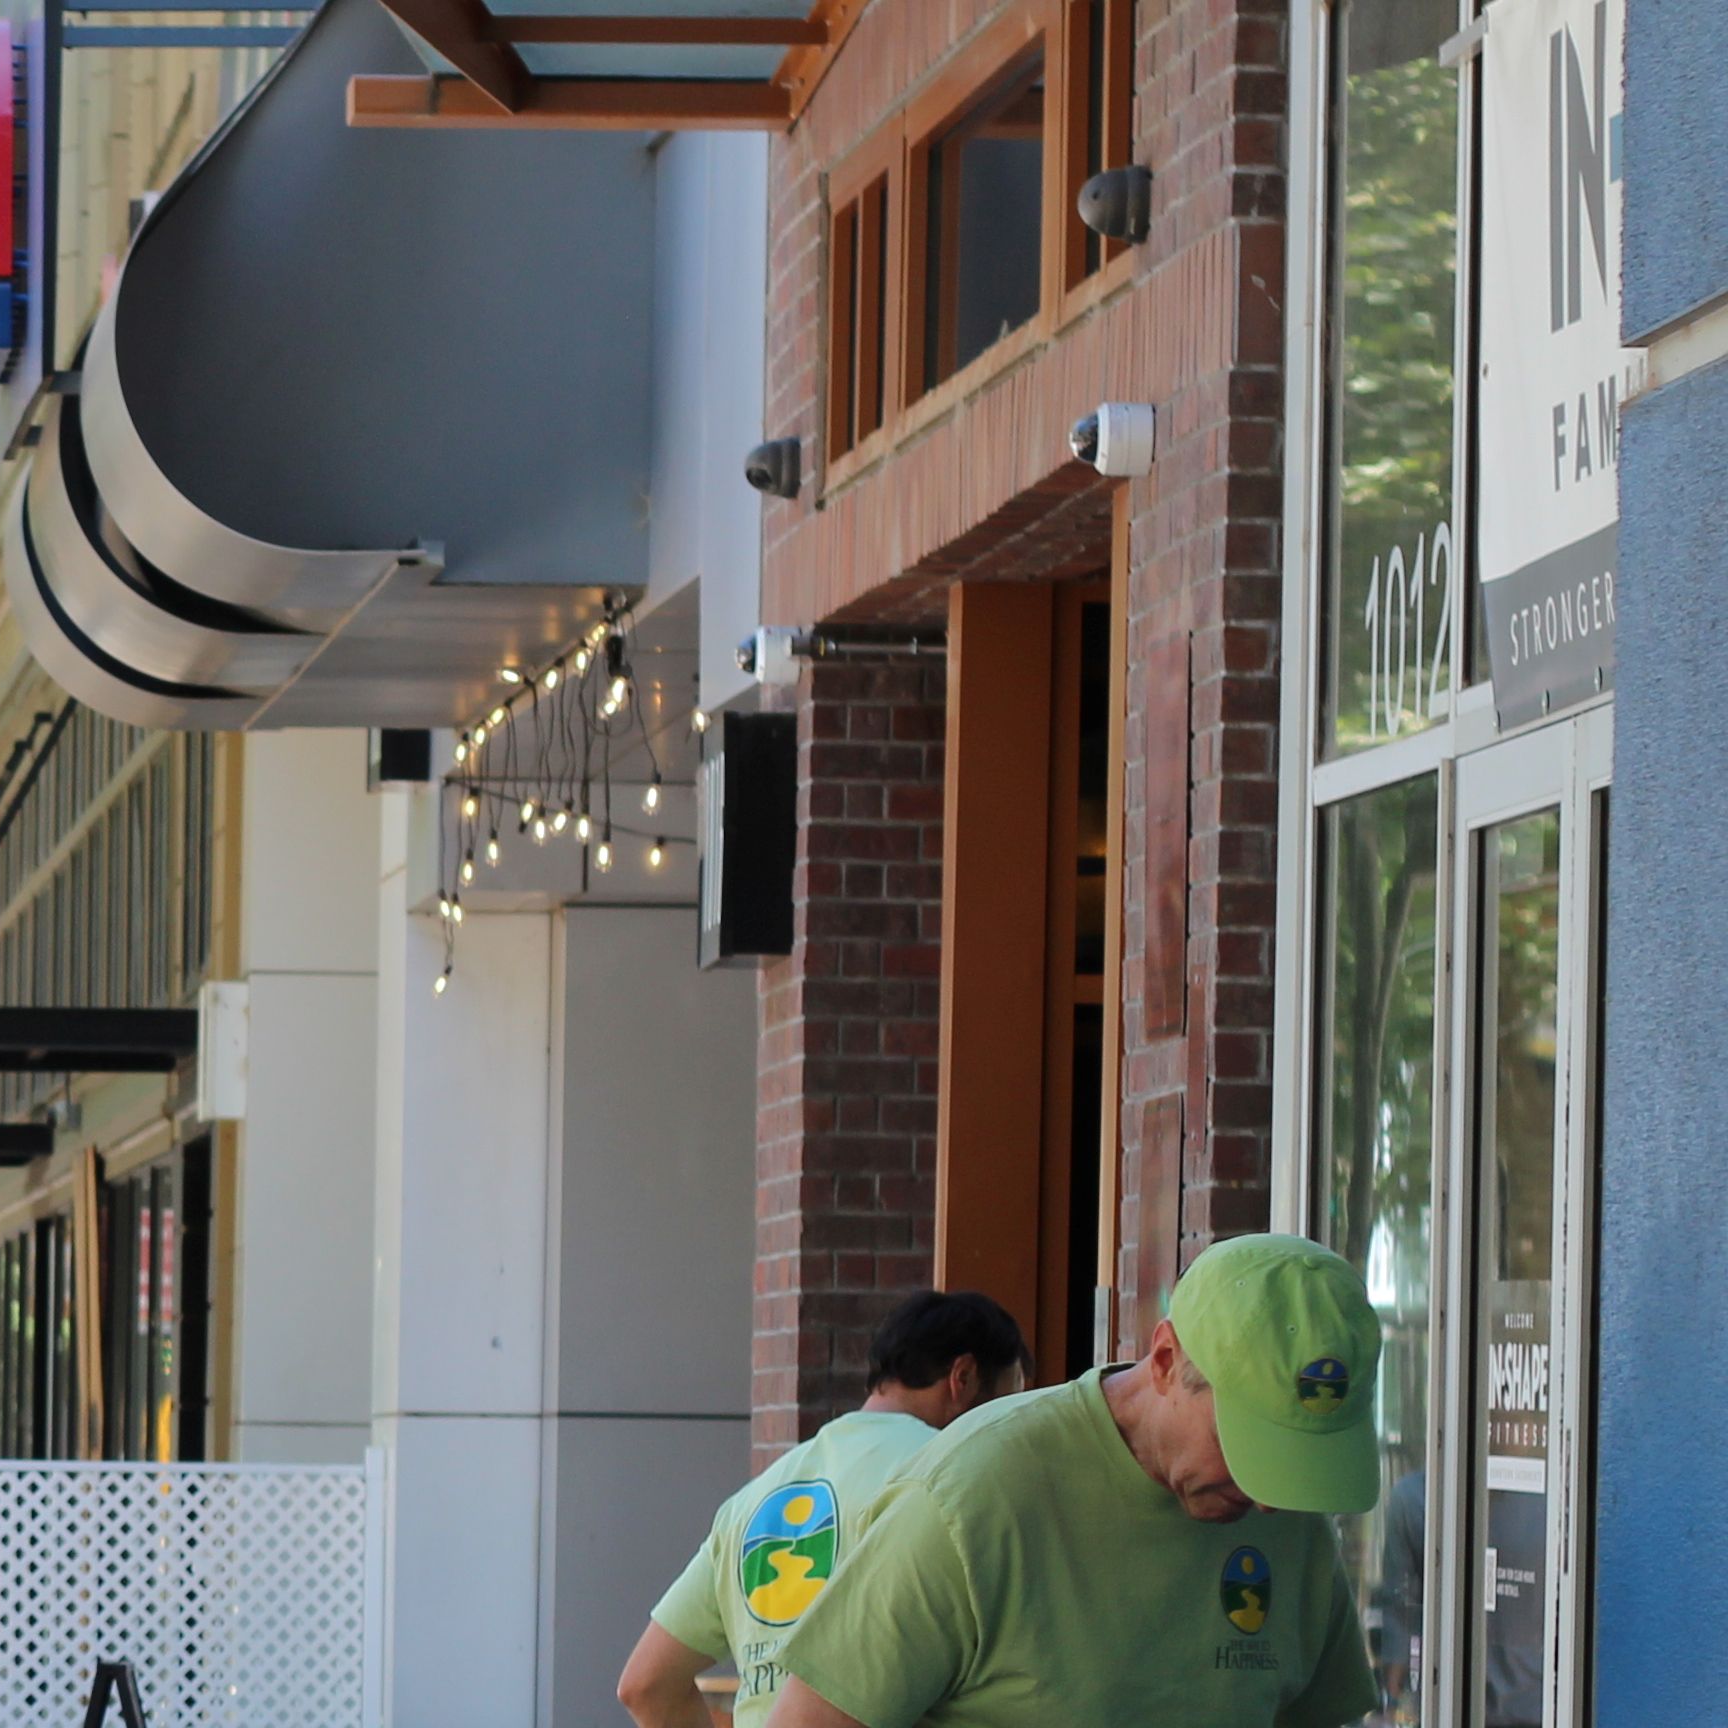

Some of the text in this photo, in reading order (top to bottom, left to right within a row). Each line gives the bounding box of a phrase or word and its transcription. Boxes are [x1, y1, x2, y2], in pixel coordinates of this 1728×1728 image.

[1365, 520, 1452, 742] 1012
[1510, 570, 1616, 666] STRONGER
[1487, 1421, 1547, 1447] FITNESS
